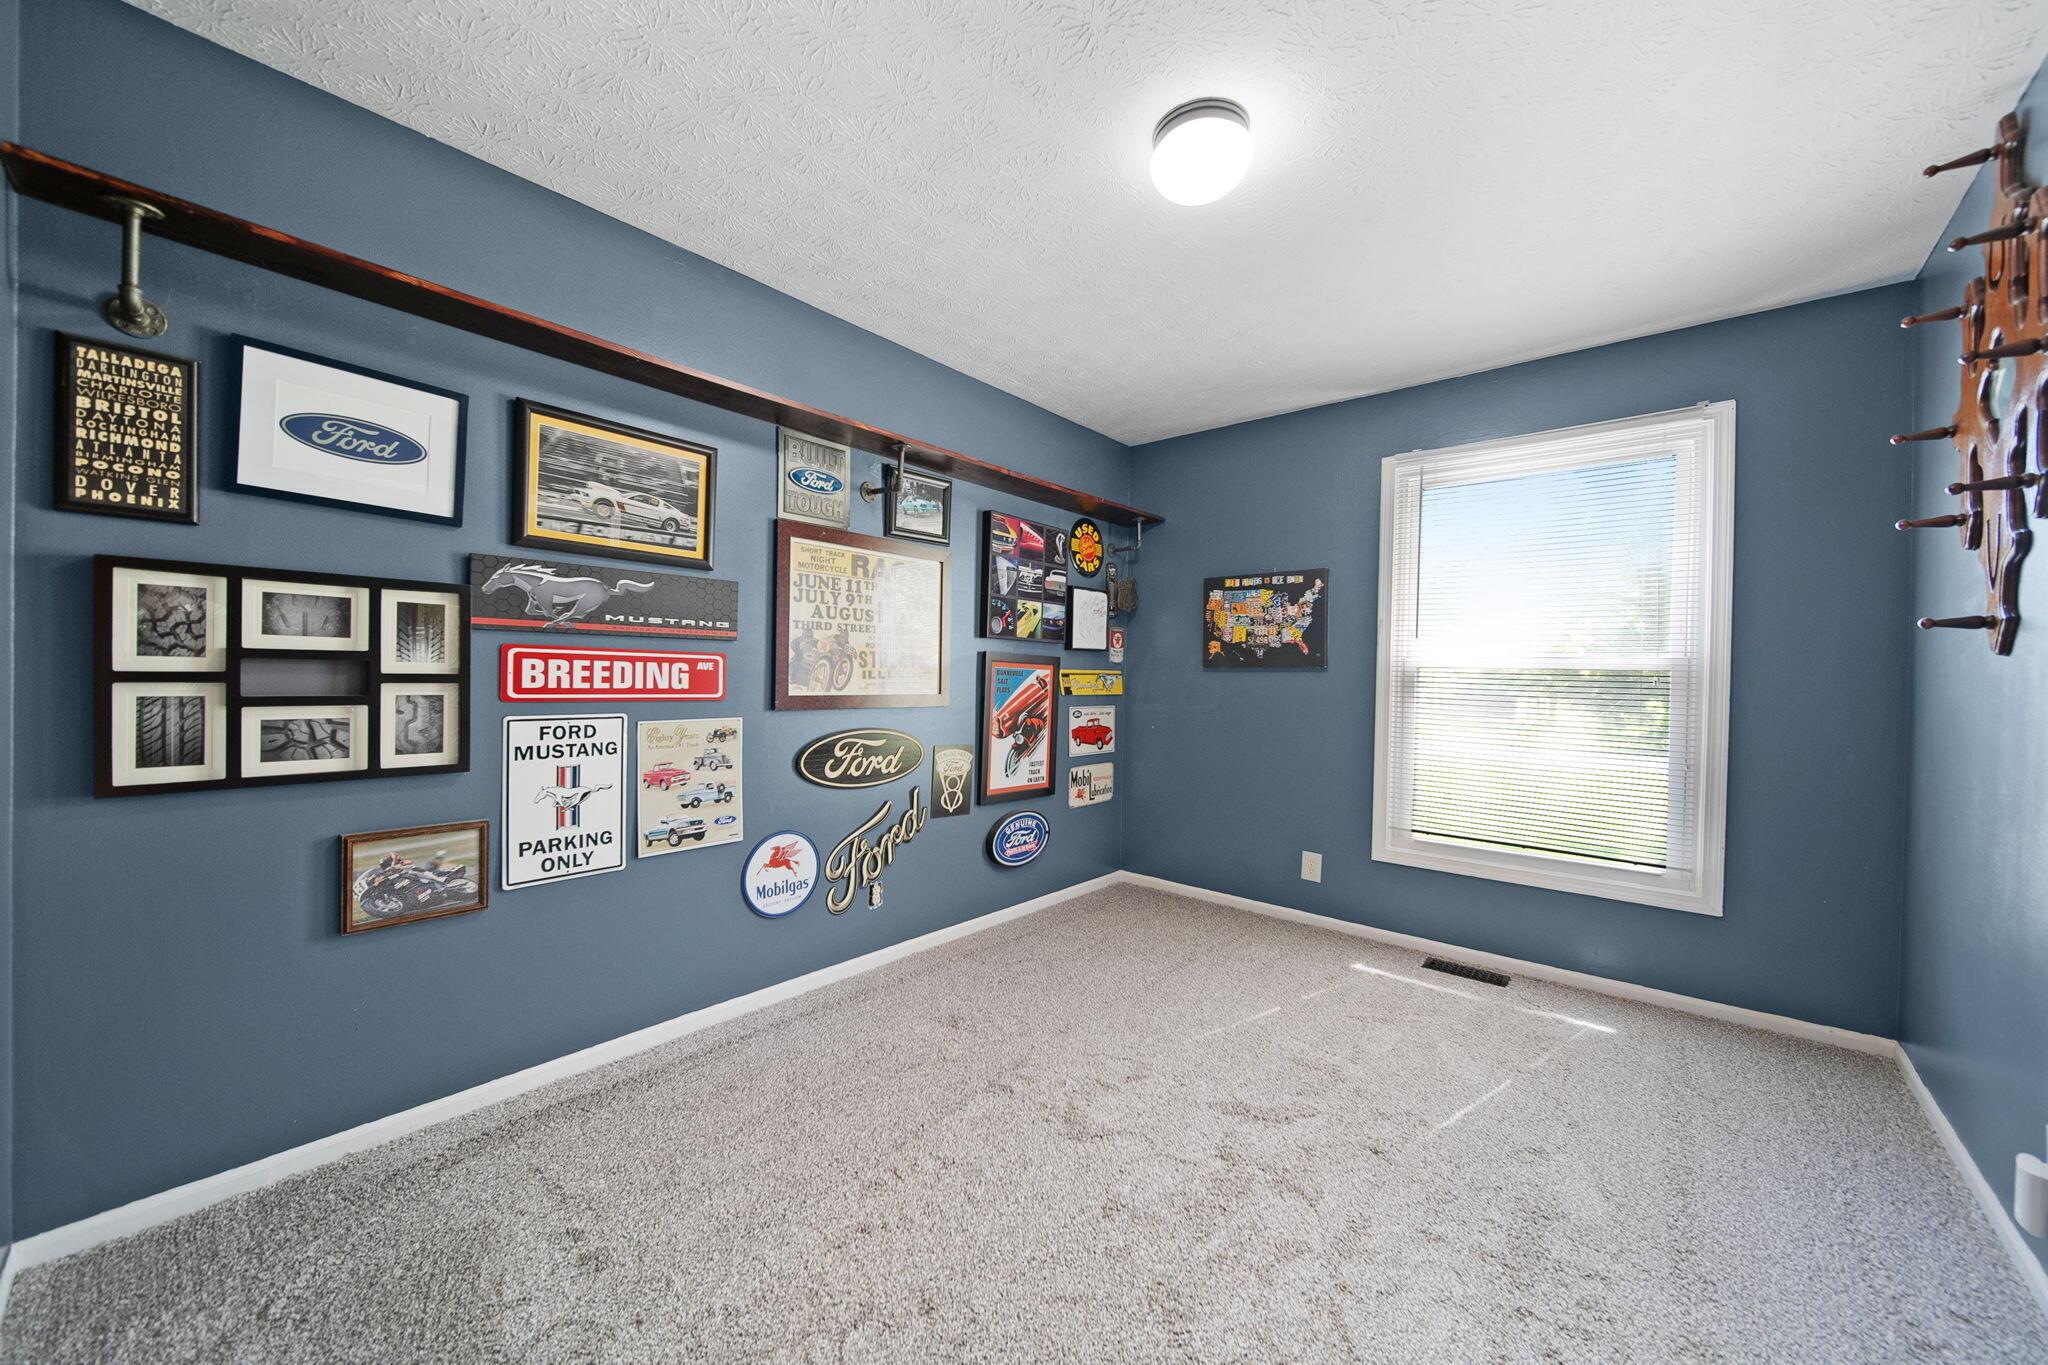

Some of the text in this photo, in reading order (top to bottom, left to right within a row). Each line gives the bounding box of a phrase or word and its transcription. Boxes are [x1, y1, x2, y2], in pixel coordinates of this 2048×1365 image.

[76, 346, 182, 377] TALLADEGA
[76, 358, 182, 387] DARLINGTON
[76, 369, 182, 396] MARTINSVILLE
[76, 378, 182, 405] CHARLOTTE
[76, 387, 182, 413] WILKESBORO
[76, 395, 182, 425] BRISTOL
[76, 408, 181, 434] DAYTONA
[76, 418, 181, 442] ROCKINGHAM
[75, 427, 181, 453] RICHMOND
[311, 420, 401, 459] Ford
[75, 439, 181, 465] ATLANTA
[75, 450, 181, 471] BIRMINGHAM
[788, 438, 845, 471] BUILT
[75, 457, 181, 479] POCONO
[75, 475, 181, 499] DOVER
[800, 470, 835, 492] Ford
[75, 487, 180, 510] PHOENIX
[786, 491, 845, 520] TOUGH
[1074, 523, 1099, 542] USED
[797, 561, 849, 575] MOTORCYCLE
[810, 554, 837, 565] NIGHT
[1075, 553, 1100, 573] CARS
[793, 572, 841, 591] JUNE
[793, 588, 842, 606] JULY
[605, 614, 730, 628] MUSTANG
[792, 619, 832, 631] THIRD
[521, 658, 715, 690] BREEDING AVE
[539, 724, 597, 741] FORD
[514, 741, 618, 761] MUSTANG
[824, 737, 905, 779] Ford
[1005, 819, 1037, 835] GENUINE
[1005, 829, 1037, 848] Ford
[518, 830, 613, 858] PARKING
[825, 785, 928, 915] Ford
[541, 850, 595, 873] ONLY
[756, 878, 809, 901] Mobilgas
